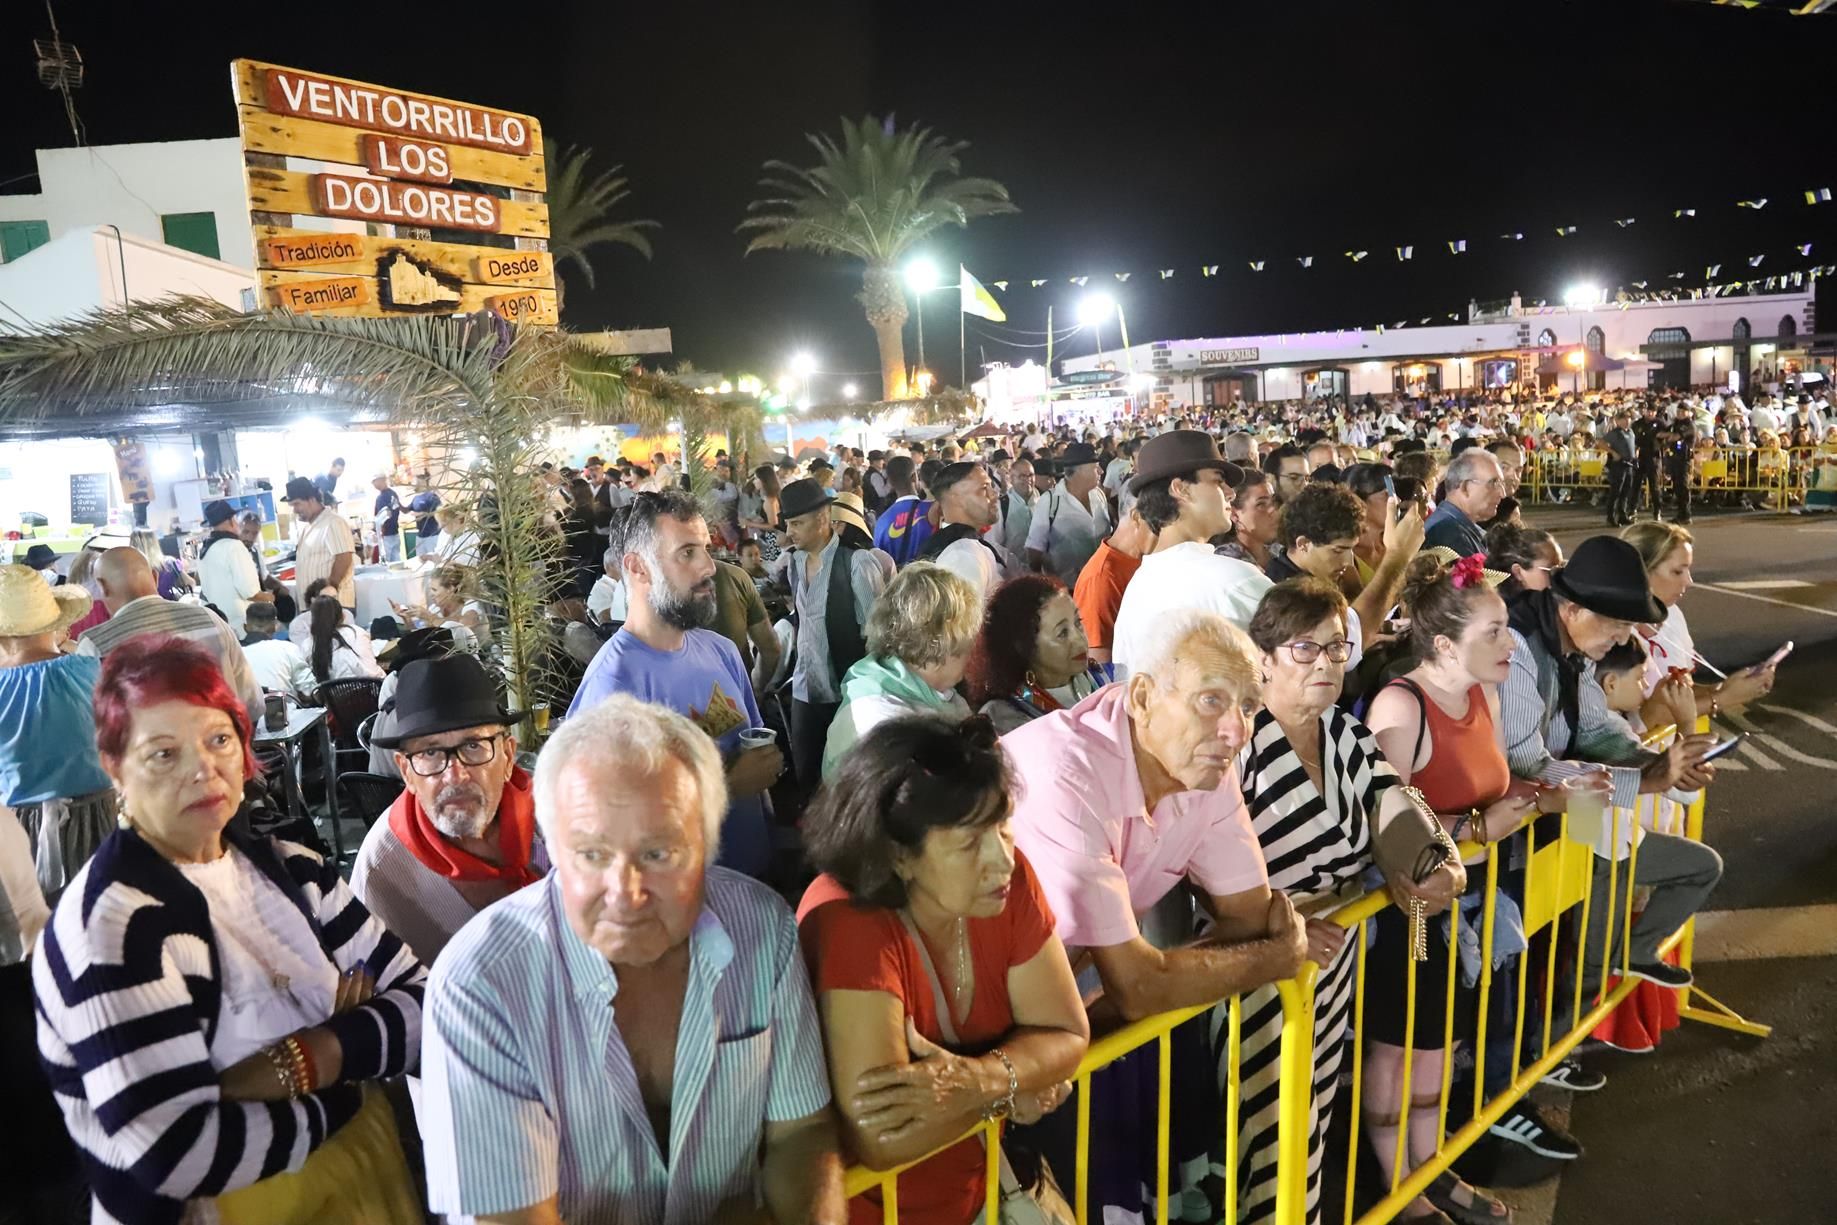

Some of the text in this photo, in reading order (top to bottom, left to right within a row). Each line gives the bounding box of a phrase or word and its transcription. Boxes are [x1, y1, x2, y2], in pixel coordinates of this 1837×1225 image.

[278, 75, 526, 147] VENTORRILLO
[377, 140, 449, 177] LOS
[325, 179, 496, 226] DOLORES
[274, 241, 355, 262] Tradición
[489, 256, 539, 278] Desde
[291, 284, 358, 306] Familiar
[1201, 349, 1257, 362] SOUVENIRS
